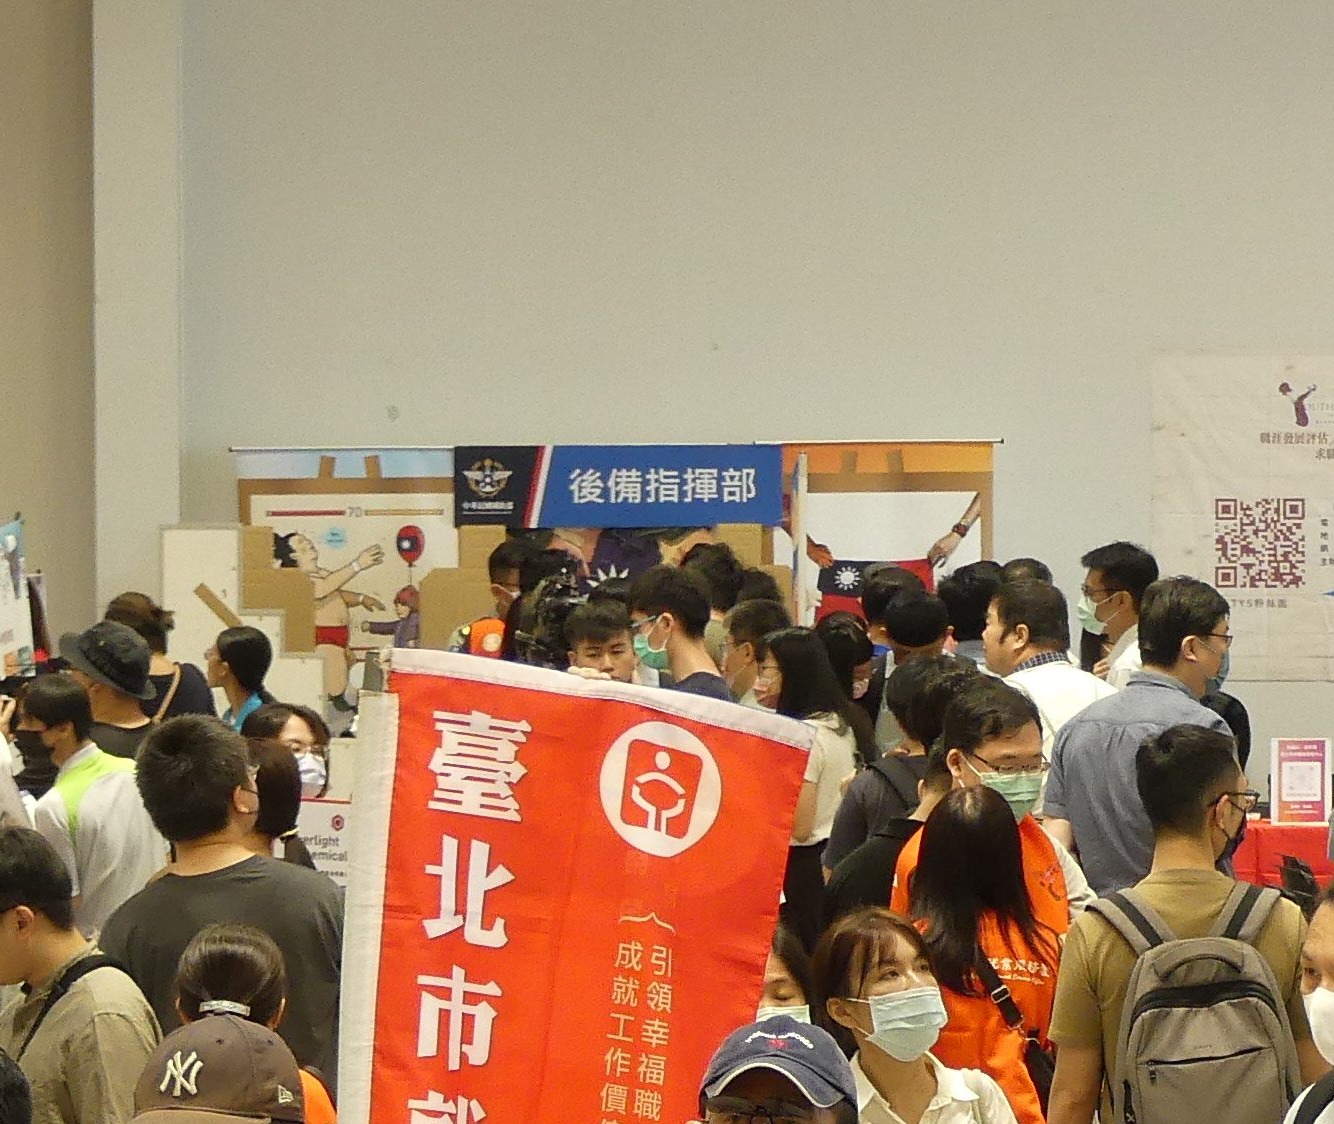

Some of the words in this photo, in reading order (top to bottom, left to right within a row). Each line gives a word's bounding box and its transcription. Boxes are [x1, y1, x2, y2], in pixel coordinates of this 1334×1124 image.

[569, 468, 756, 504] 後備指揮部
[159, 1050, 204, 1097] NY
